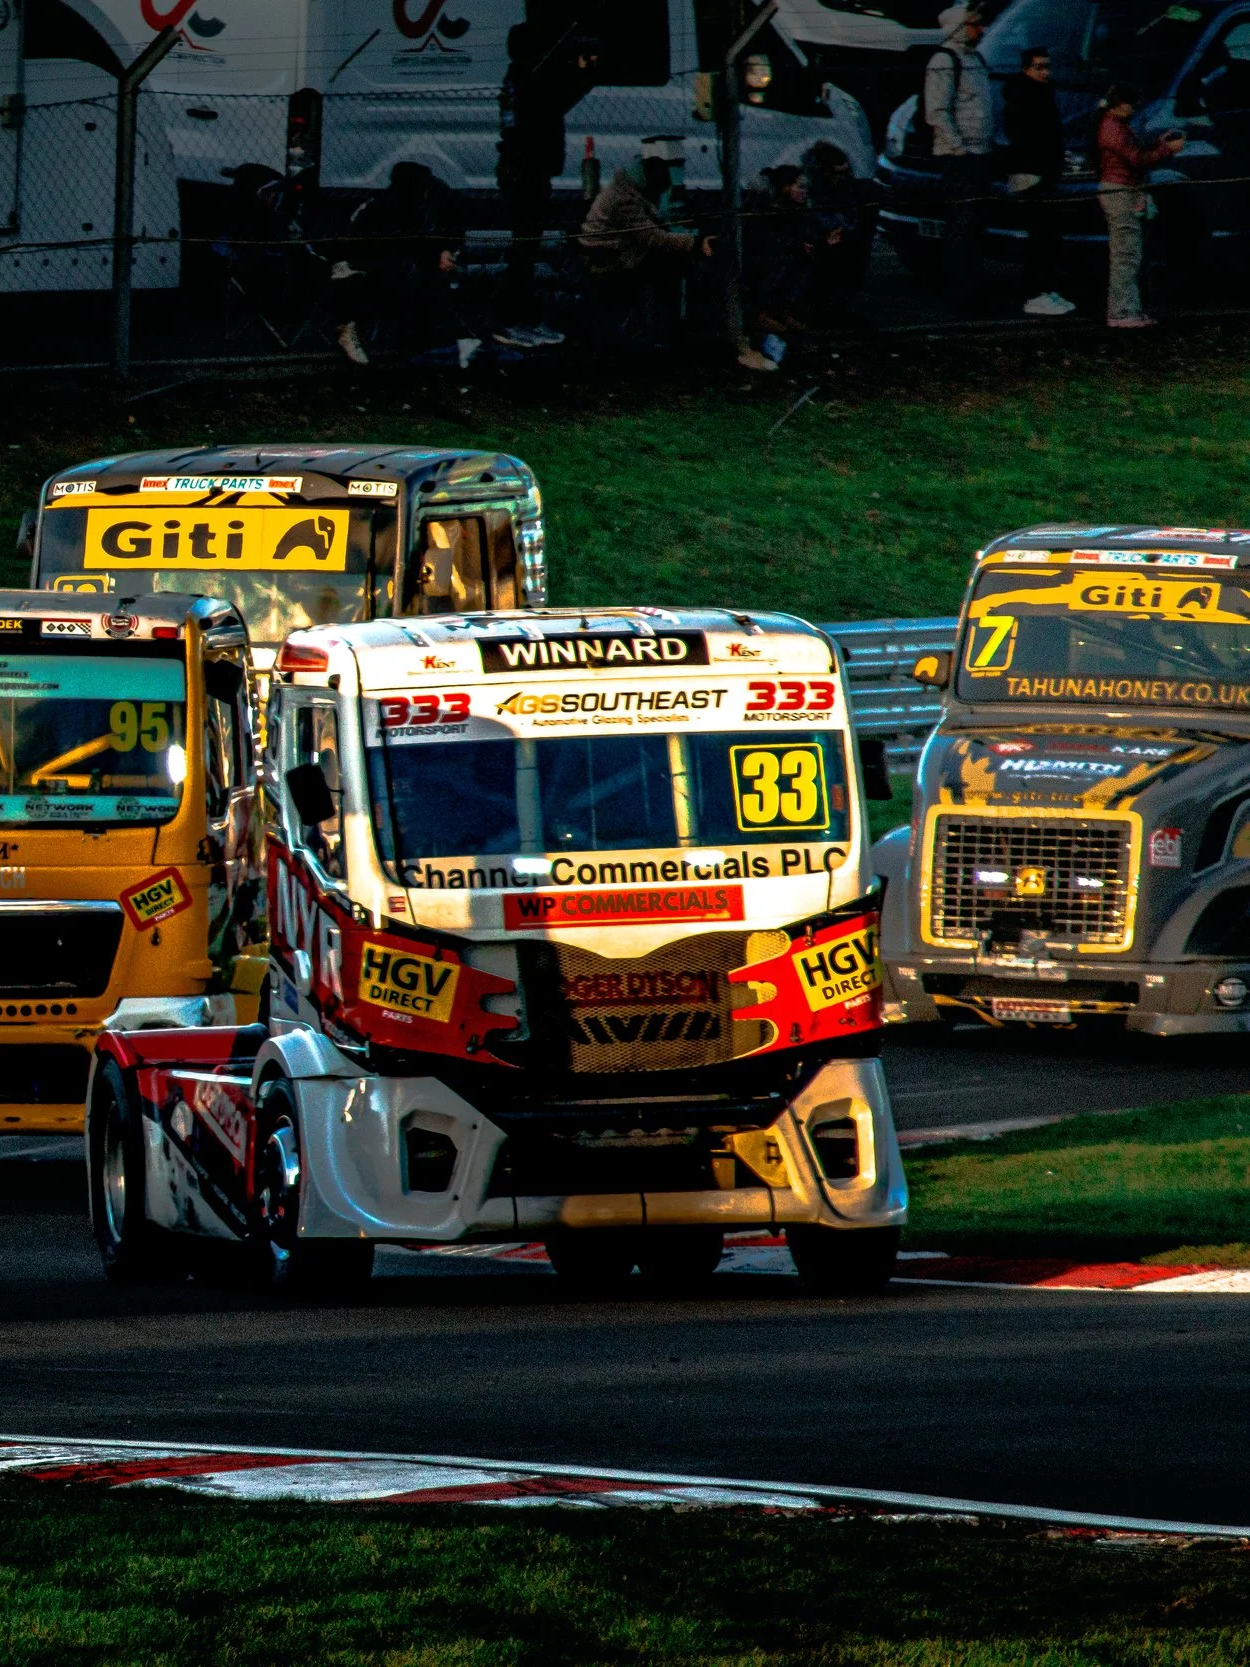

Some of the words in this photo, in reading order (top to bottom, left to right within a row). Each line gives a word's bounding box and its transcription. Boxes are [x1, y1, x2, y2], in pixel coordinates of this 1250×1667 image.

[54, 482, 94, 494] MOTIS
[174, 478, 217, 490] TRUCK
[220, 478, 264, 490] PARTS
[350, 483, 395, 494] MOTIS
[101, 519, 244, 559] Giti
[1152, 554, 1198, 565] ARTS
[1081, 586, 1162, 608] Giti
[500, 637, 687, 667] WINNARD
[973, 616, 1015, 667] 7
[745, 681, 836, 711] 333
[1007, 677, 1250, 704] TAHUNAHONEY.CO.UK
[379, 692, 471, 727] 333
[532, 716, 588, 727] Automotive
[592, 715, 633, 725] Glazing
[637, 714, 690, 724] Specialists
[743, 712, 832, 722] MOTORSPORT
[110, 701, 169, 752] 95
[742, 750, 818, 823] 33
[25, 803, 94, 812] NETWORK
[780, 847, 847, 876] PLC
[132, 879, 173, 910] HGV
[518, 897, 557, 917] WP
[561, 889, 729, 915] COMMERCIALS
[363, 948, 452, 996] HGV
[800, 931, 875, 988] HGV
[821, 968, 876, 1000] DIRECT
[370, 985, 433, 1012] DIRECT
[381, 1009, 414, 1024] PARTS
